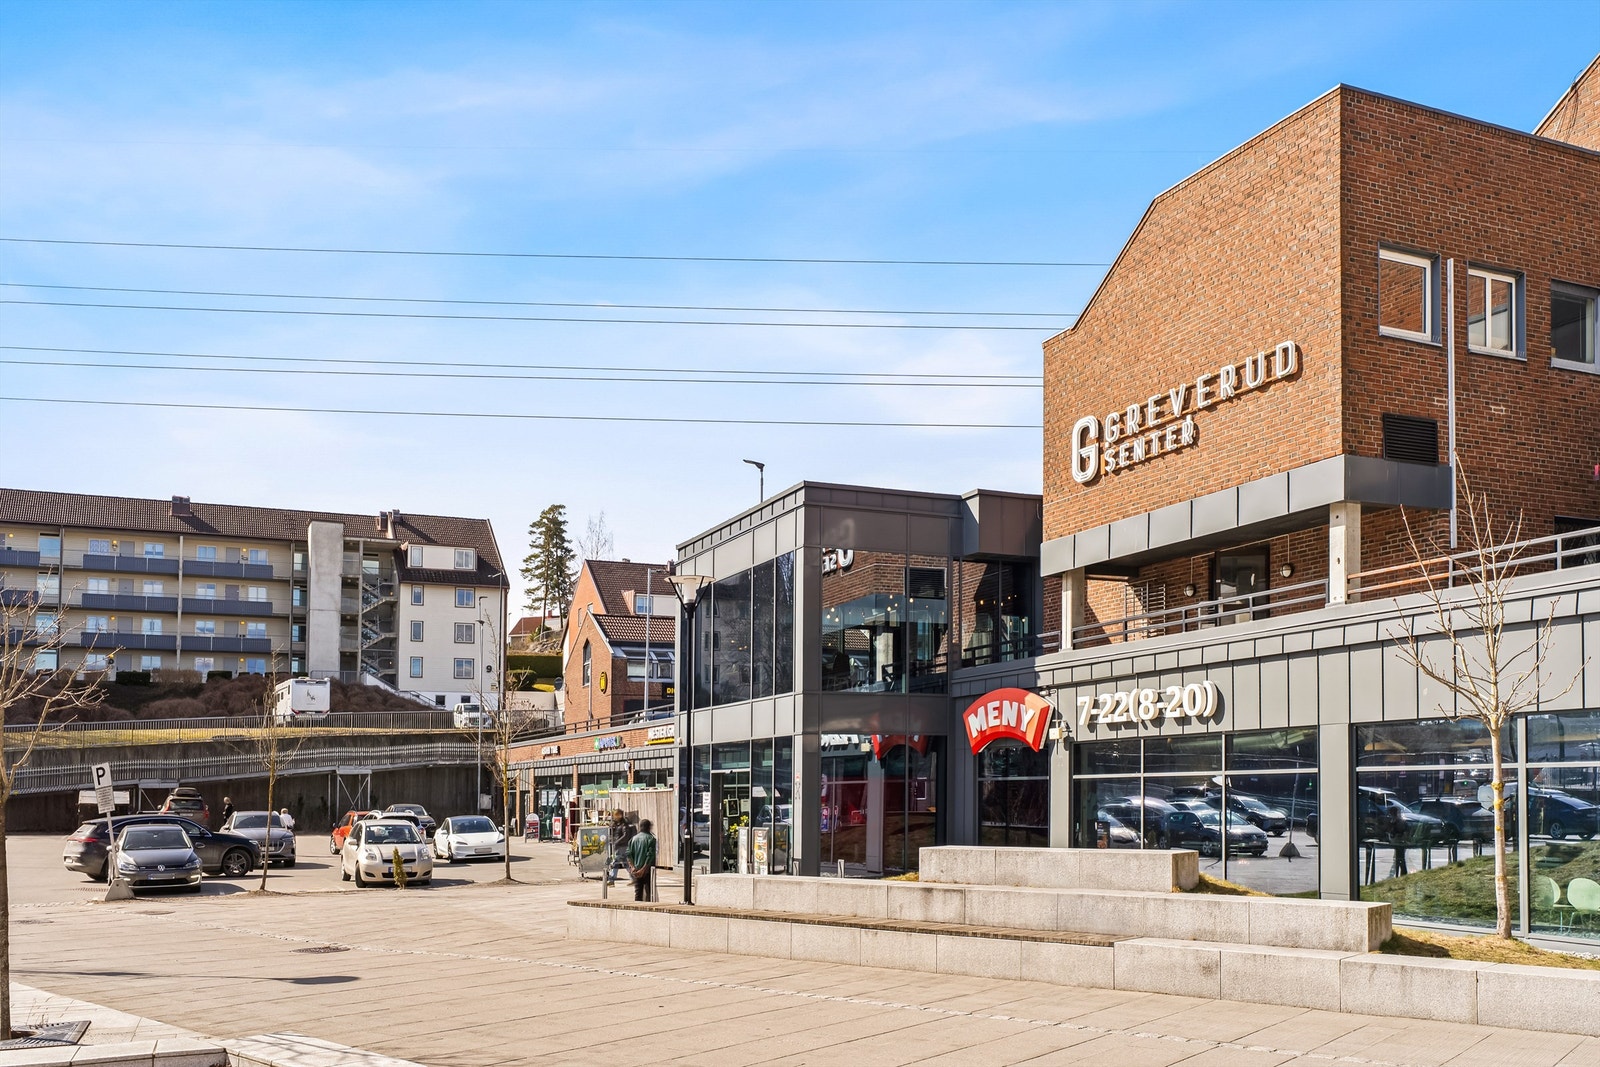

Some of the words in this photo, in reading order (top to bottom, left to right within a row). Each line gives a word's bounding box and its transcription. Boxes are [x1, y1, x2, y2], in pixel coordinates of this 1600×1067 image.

[1105, 340, 1296, 443] GREVERUD
[1071, 415, 1099, 484] G
[1104, 419, 1195, 473] SENTER
[967, 700, 1035, 739] MENY
[95, 766, 106, 786] P
